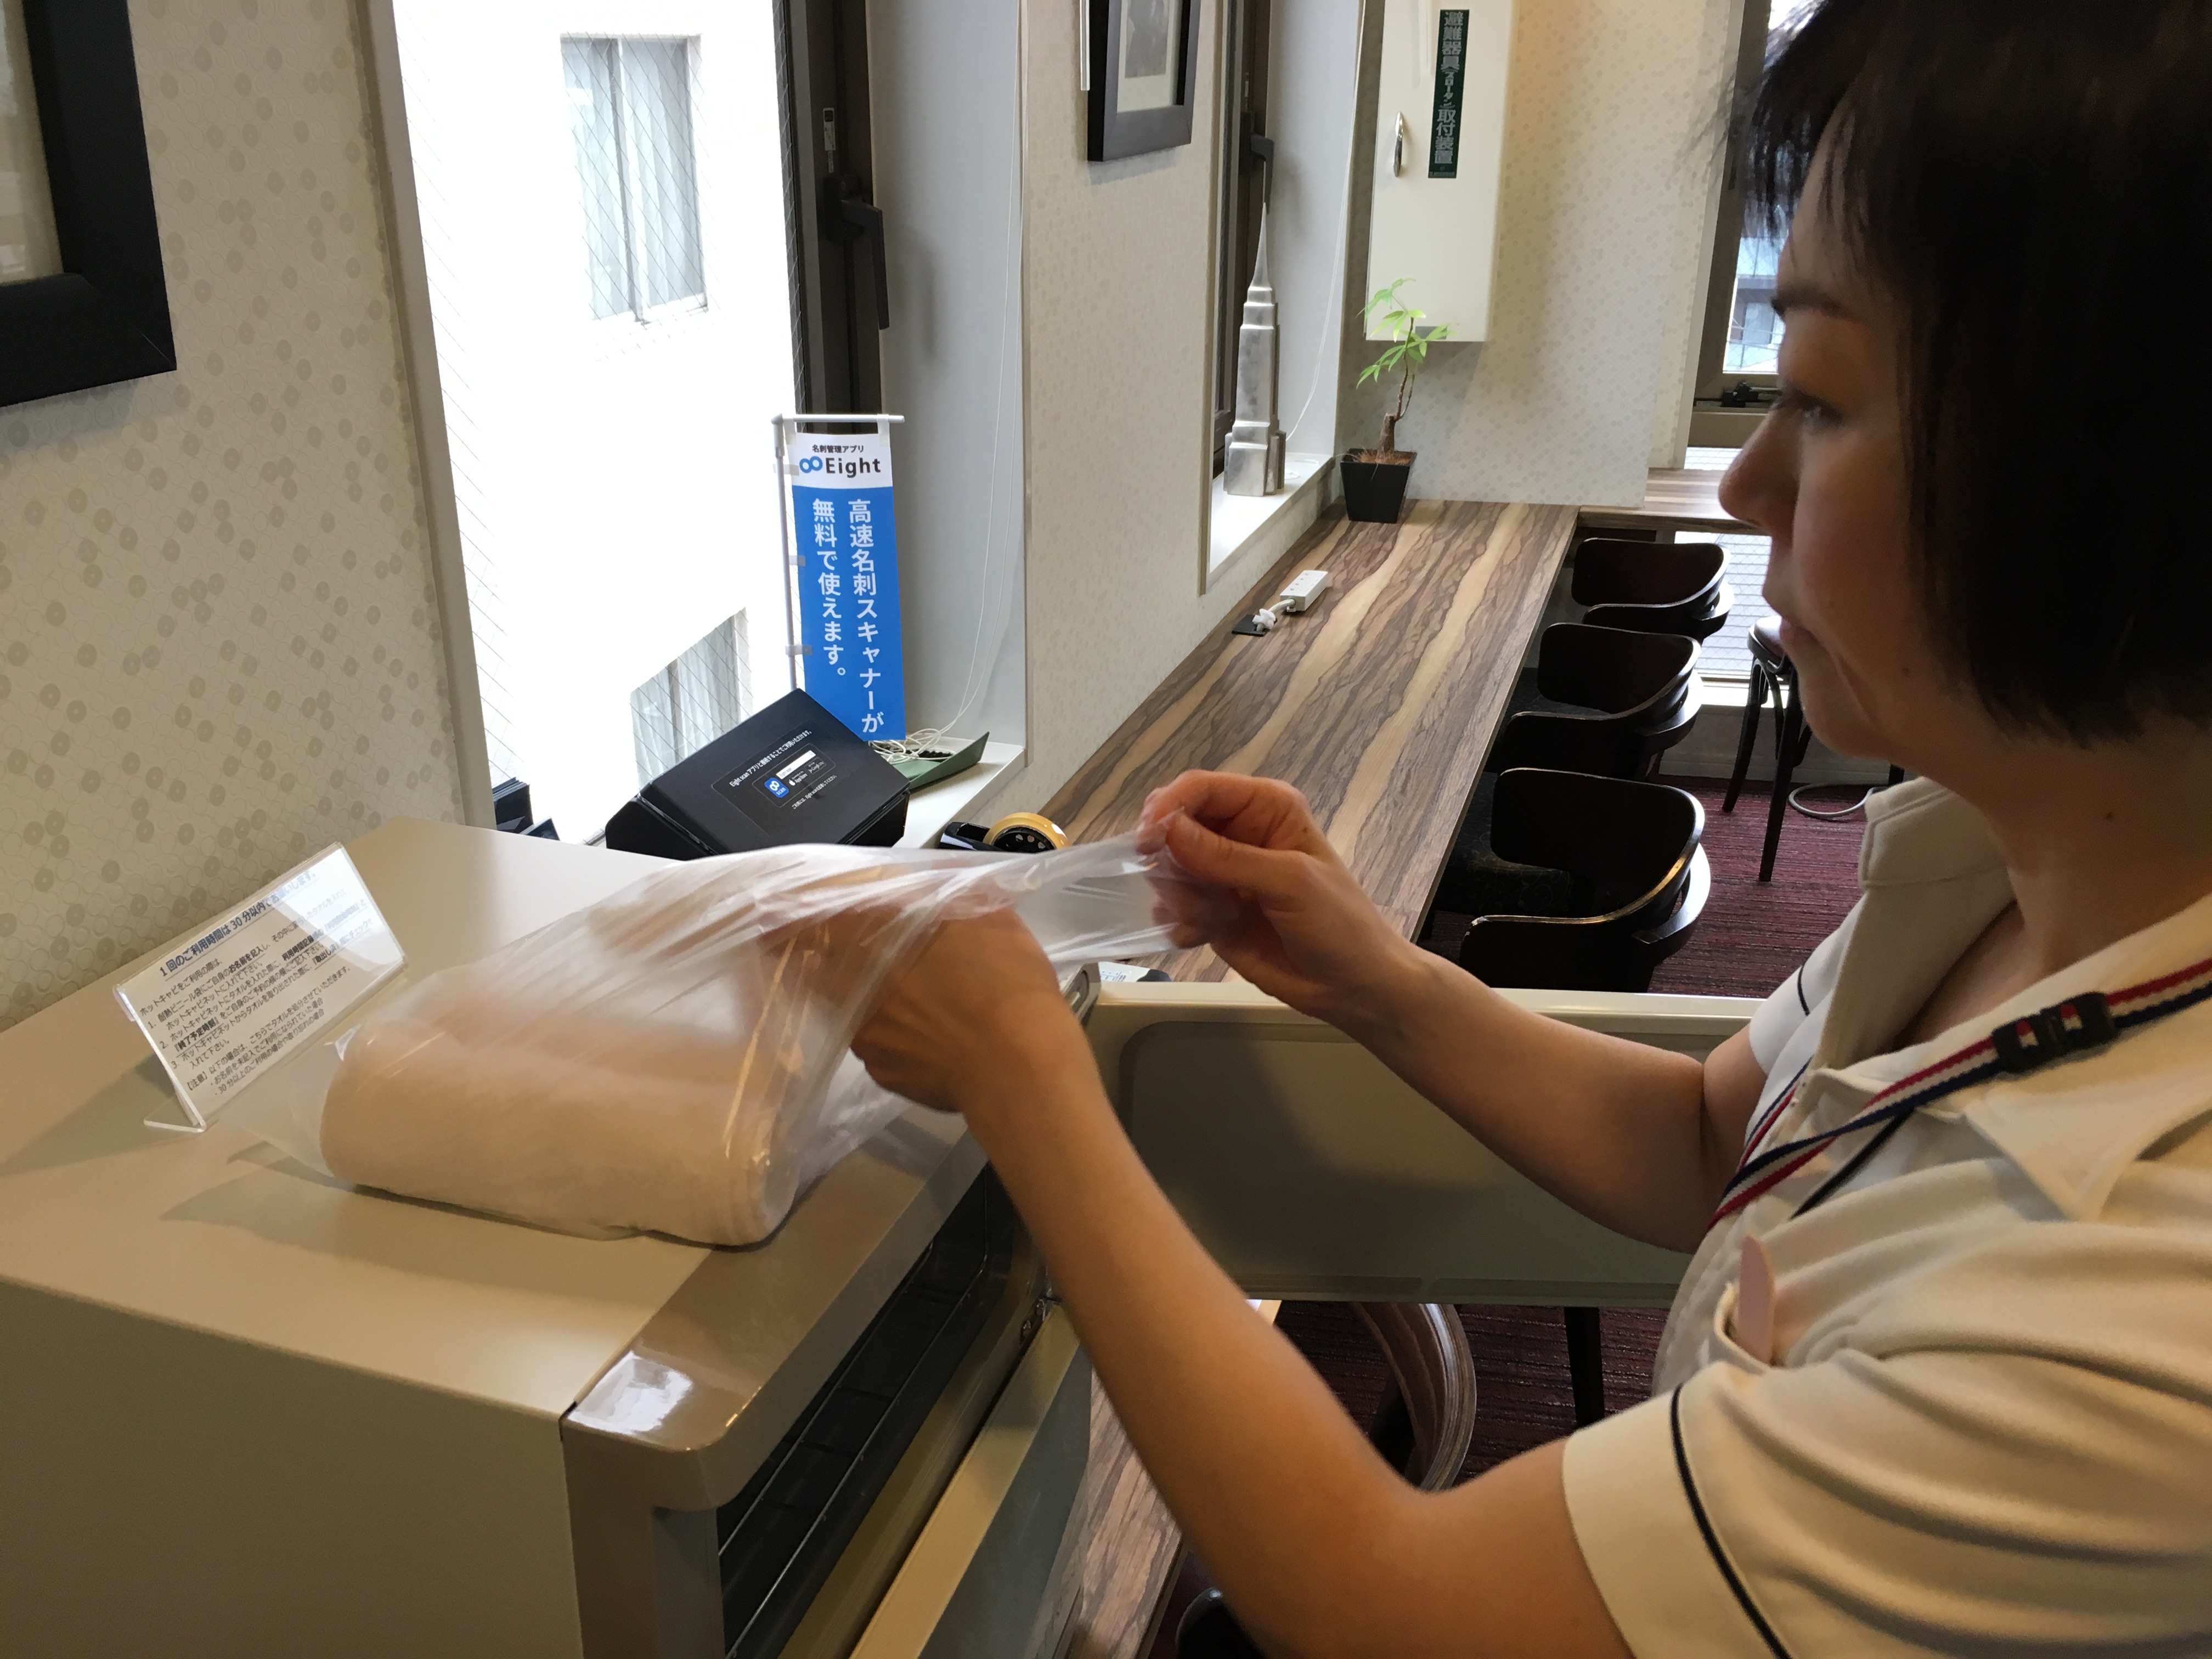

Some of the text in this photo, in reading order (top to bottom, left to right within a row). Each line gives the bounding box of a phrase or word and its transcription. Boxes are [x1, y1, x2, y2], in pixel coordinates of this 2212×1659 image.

[812, 444, 864, 453] 名刺管理アプリ
[825, 458, 881, 478] Eight
[812, 498, 846, 676] 無料で使えます。
[848, 499, 884, 733] 高速名刺スキャナーが
[775, 787, 787, 795] scan
